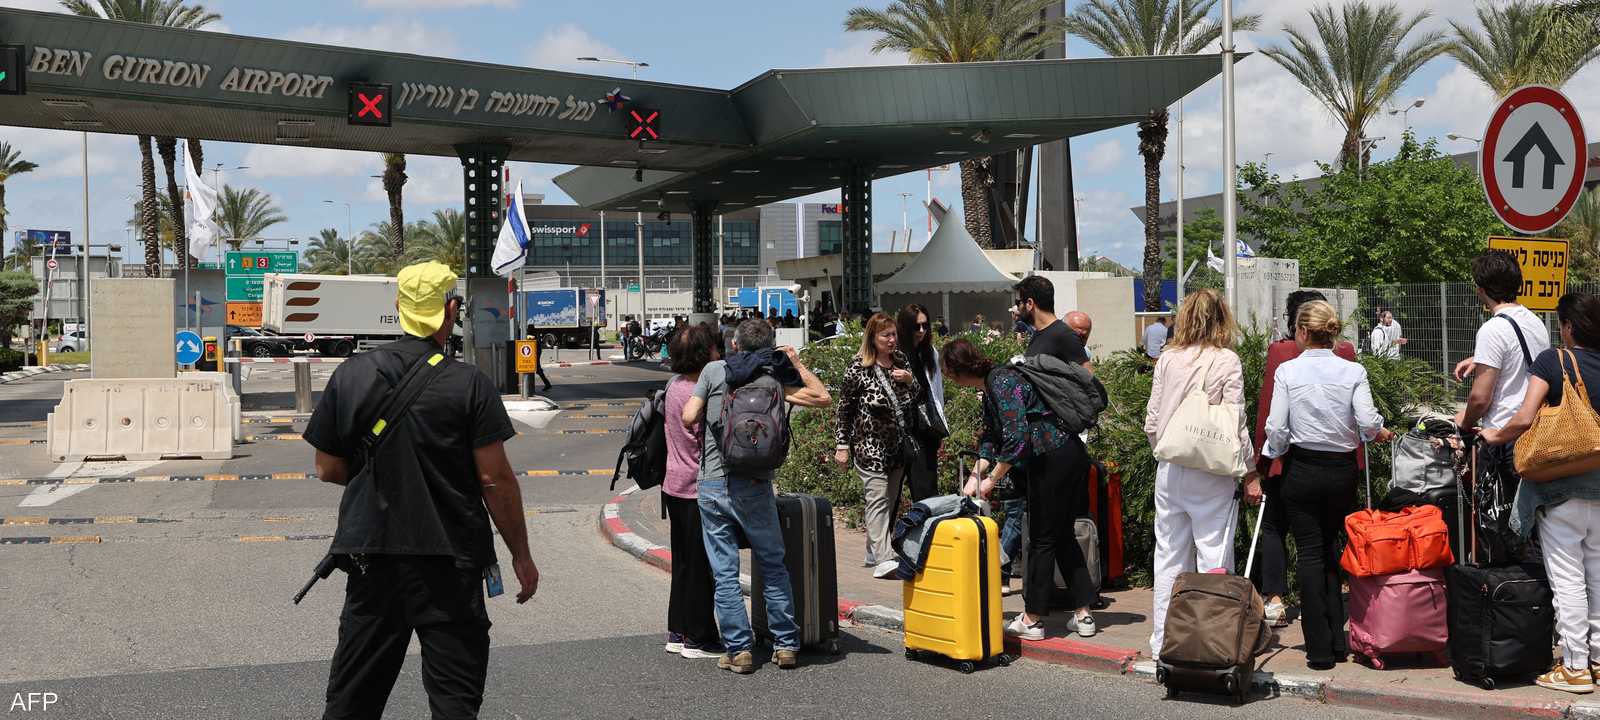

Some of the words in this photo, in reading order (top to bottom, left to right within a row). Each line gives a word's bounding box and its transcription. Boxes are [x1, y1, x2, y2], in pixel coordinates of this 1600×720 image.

[29, 46, 92, 78] BEN
[103, 54, 212, 89] GURION
[219, 66, 335, 99] AIRPORT
[397, 81, 458, 111] גוריון
[453, 87, 479, 115] בן
[484, 89, 561, 117] התעופה
[558, 94, 596, 121] נמל
[821, 203, 848, 214] FedE
[532, 223, 577, 236] swissport
[259, 258, 266, 268] 3
[1533, 249, 1564, 268] כניסה
[1538, 280, 1561, 298] רכב
